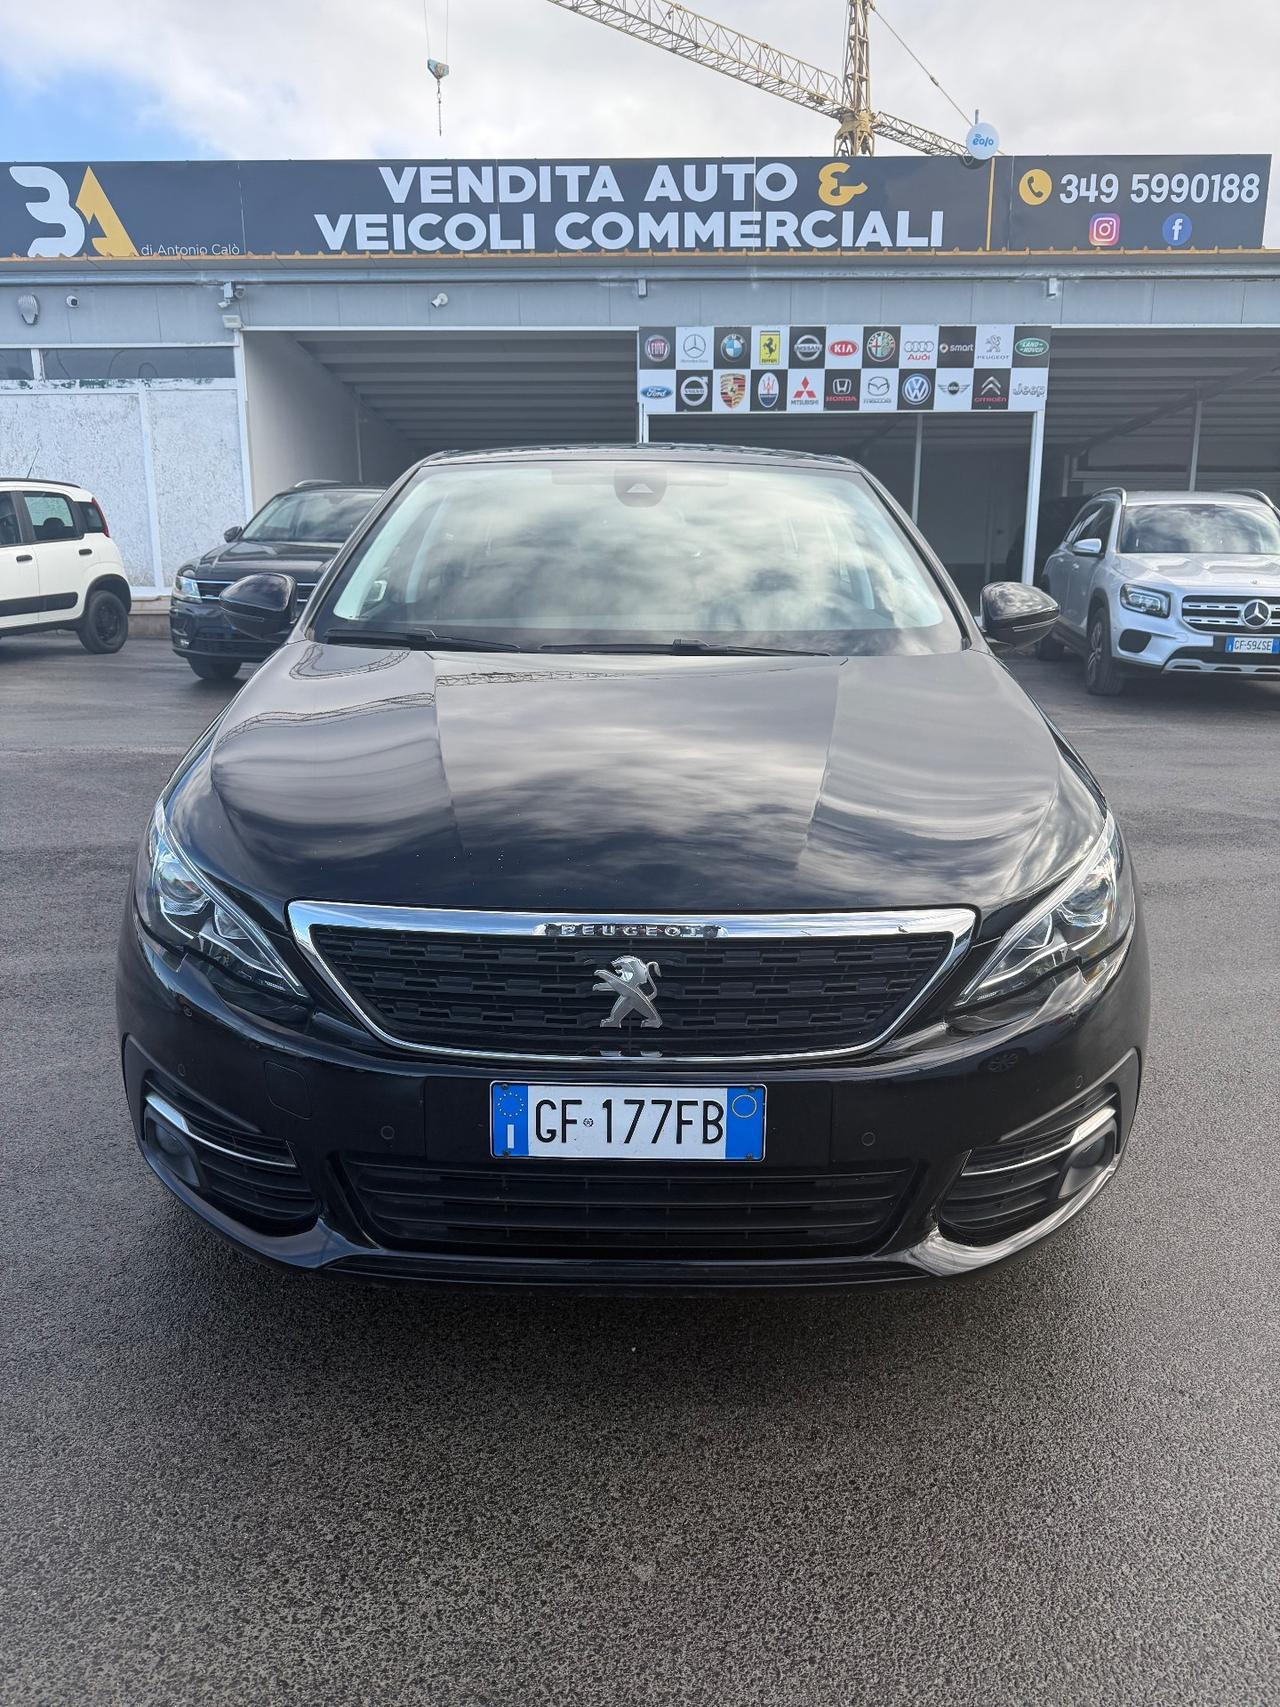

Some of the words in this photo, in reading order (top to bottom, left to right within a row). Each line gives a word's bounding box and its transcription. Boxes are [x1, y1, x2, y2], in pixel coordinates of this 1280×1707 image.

[973, 137, 994, 147] eolo
[378, 165, 625, 203] VENDITA
[643, 162, 798, 202] AUTO
[818, 162, 868, 206] &
[1059, 173, 1119, 204] 349
[1130, 173, 1260, 204] 5990188
[314, 212, 536, 251] VEICOLI
[554, 210, 944, 250] COMMERCIALI
[141, 244, 153, 256] di
[158, 244, 207, 256] Antonio
[211, 243, 240, 256] Calò
[651, 342, 665, 355] FIAT
[834, 344, 853, 353] KIA
[949, 344, 974, 352] smart
[907, 353, 930, 361] Audi
[646, 389, 666, 397] Ford
[1013, 383, 1045, 397] Jeep
[561, 924, 700, 937] PEUGEOT
